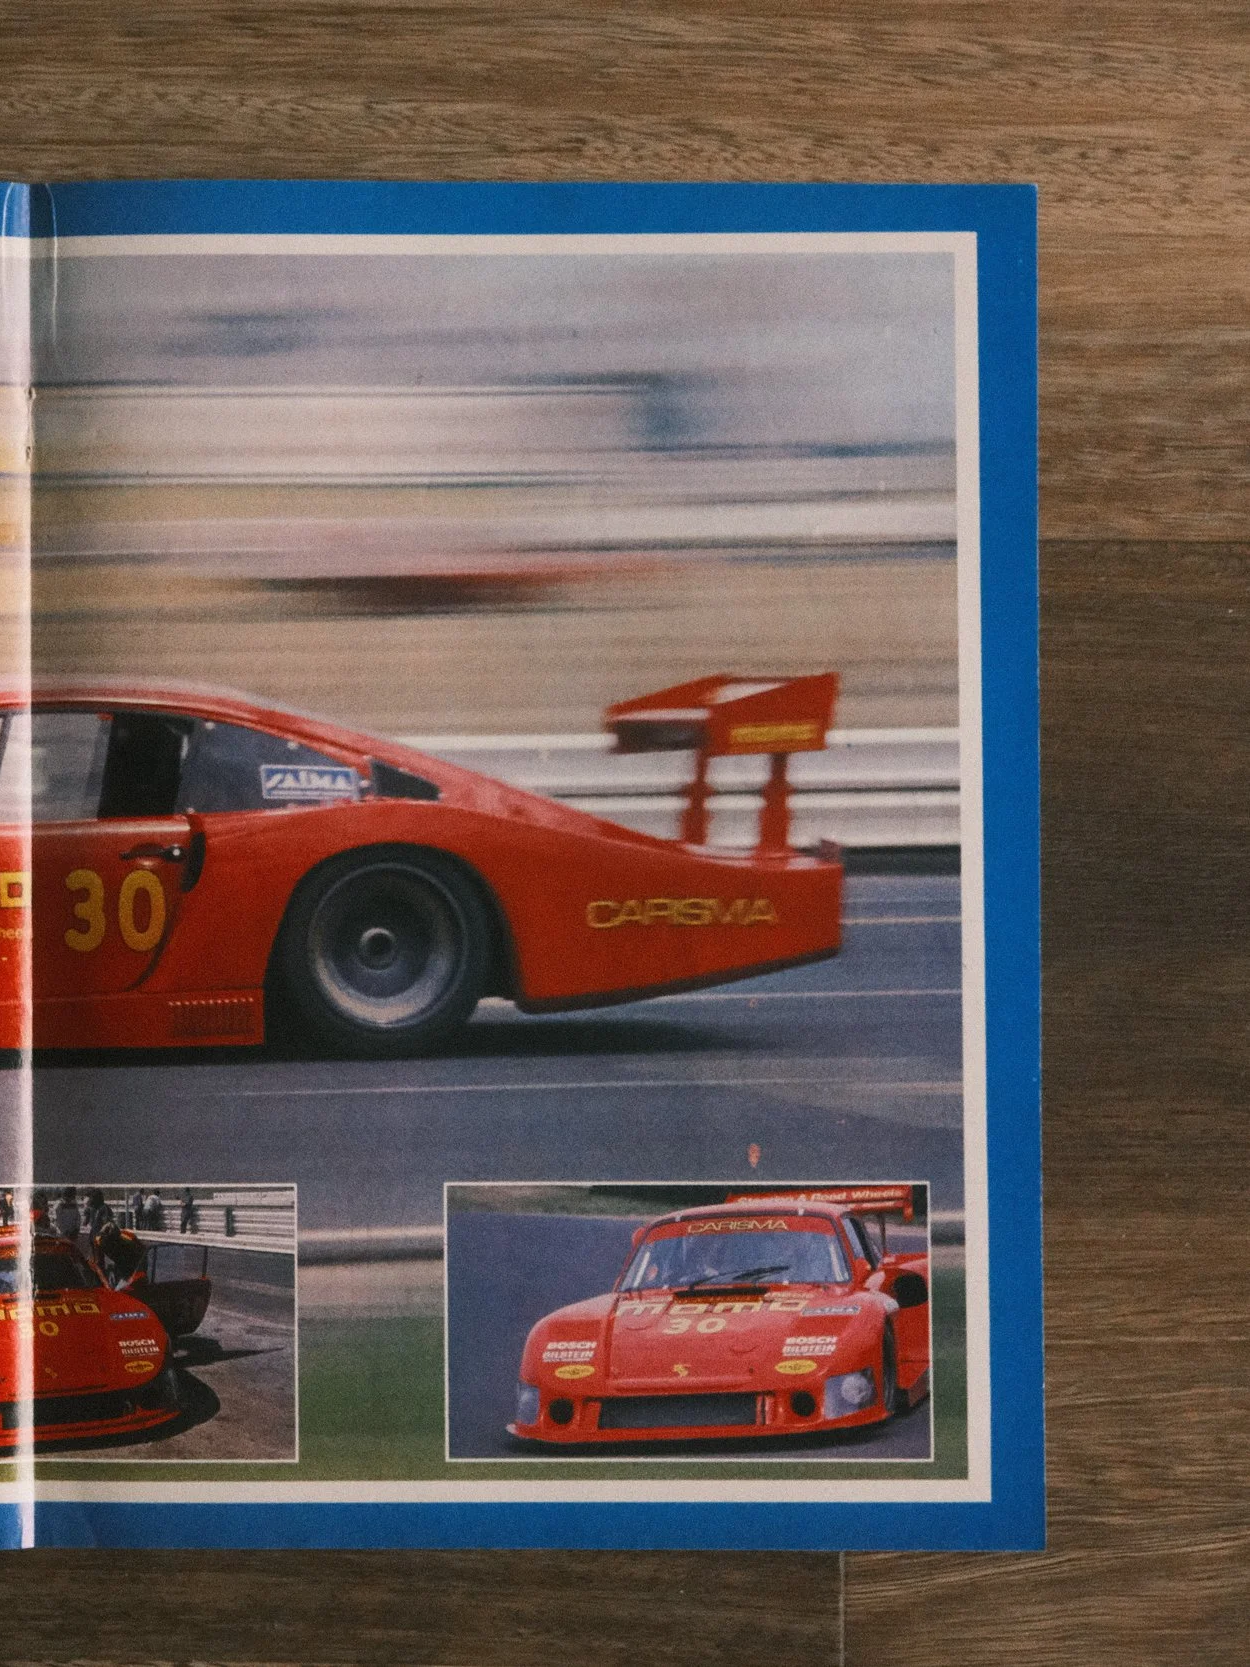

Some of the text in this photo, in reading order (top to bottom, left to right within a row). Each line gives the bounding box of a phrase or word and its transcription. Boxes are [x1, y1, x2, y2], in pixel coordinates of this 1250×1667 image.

[63, 868, 166, 951] 30
[586, 898, 779, 929] CARISMA
[688, 1220, 788, 1234] CARISMA
[615, 1299, 808, 1317] momo
[661, 1318, 727, 1334] 30
[546, 1341, 597, 1350] BOSCH
[784, 1335, 838, 1345] BOSCH
